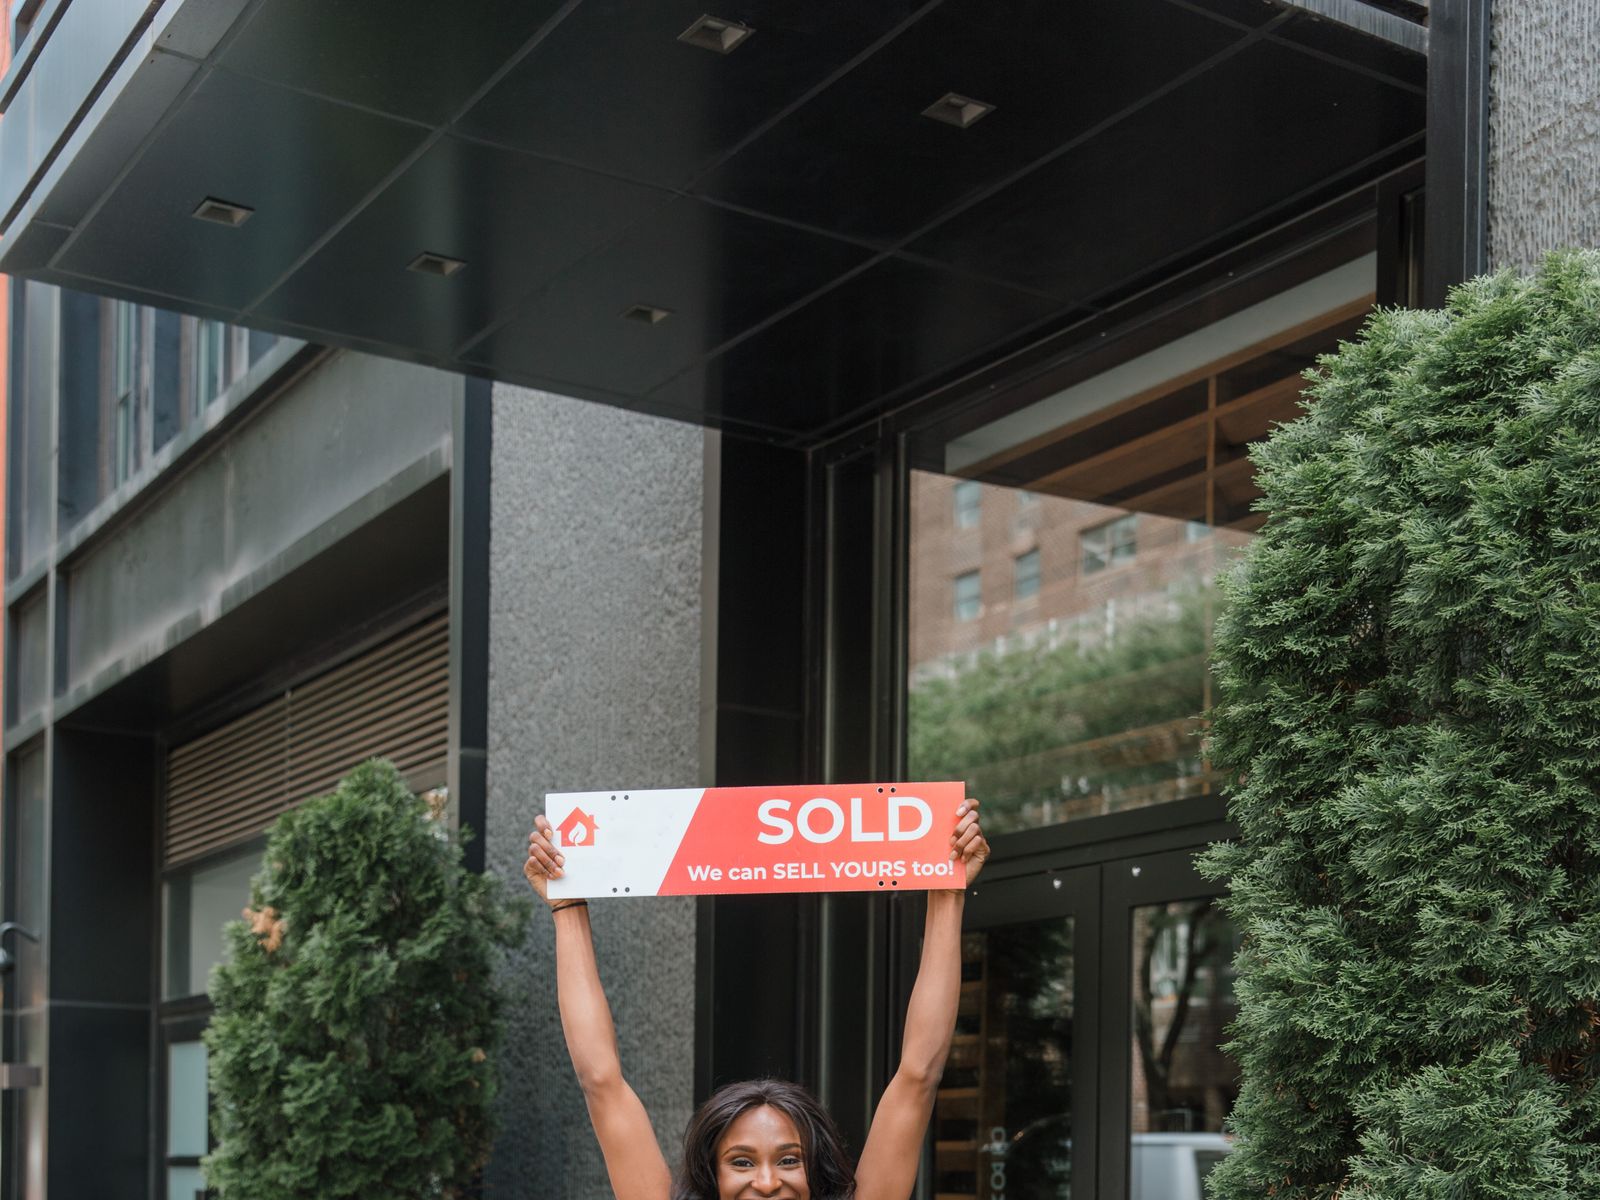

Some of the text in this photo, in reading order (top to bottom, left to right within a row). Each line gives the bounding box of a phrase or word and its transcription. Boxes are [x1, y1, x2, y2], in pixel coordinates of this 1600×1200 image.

[757, 796, 933, 845] SOLD
[687, 859, 954, 881] We can SELL YOURS too!
